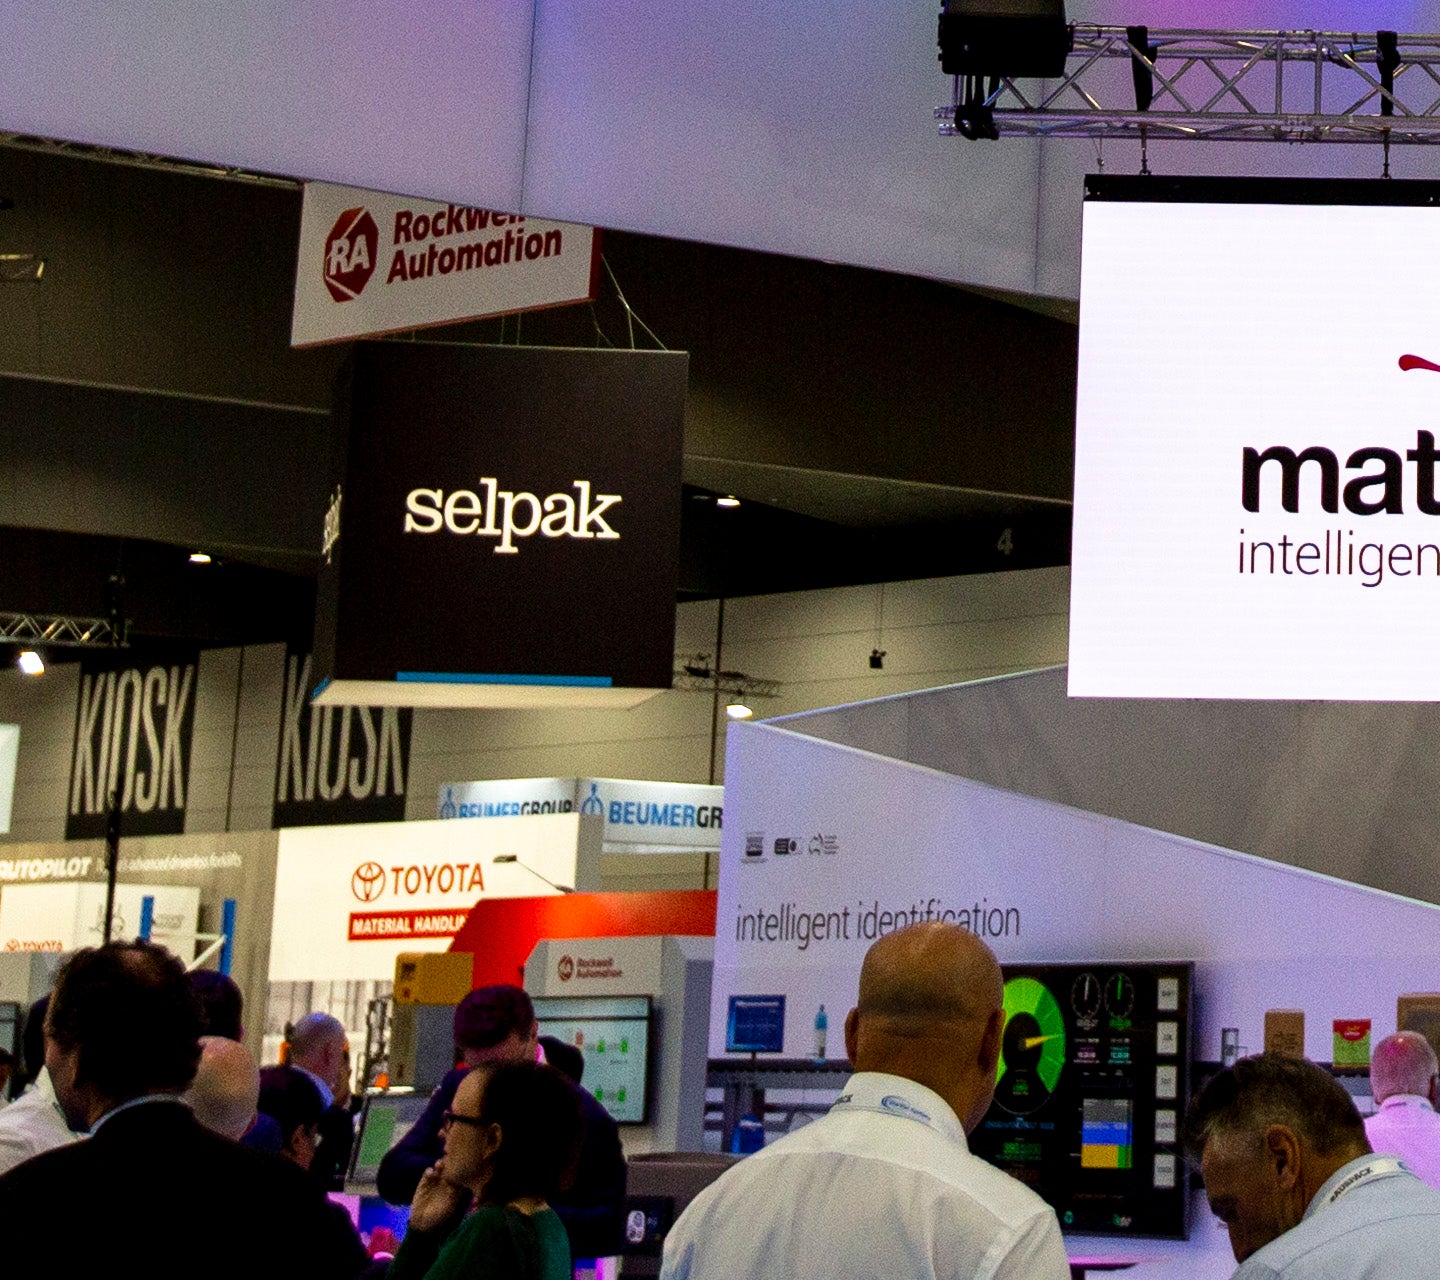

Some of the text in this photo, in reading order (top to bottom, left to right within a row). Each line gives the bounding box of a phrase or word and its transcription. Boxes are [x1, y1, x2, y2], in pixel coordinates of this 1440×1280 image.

[386, 227, 563, 285] Automation
[403, 477, 623, 554] selpak
[71, 663, 195, 815] KIOSK
[391, 862, 485, 894] TOYOTA
[351, 916, 411, 936] MATERIAL
[736, 902, 851, 950] intelligent
